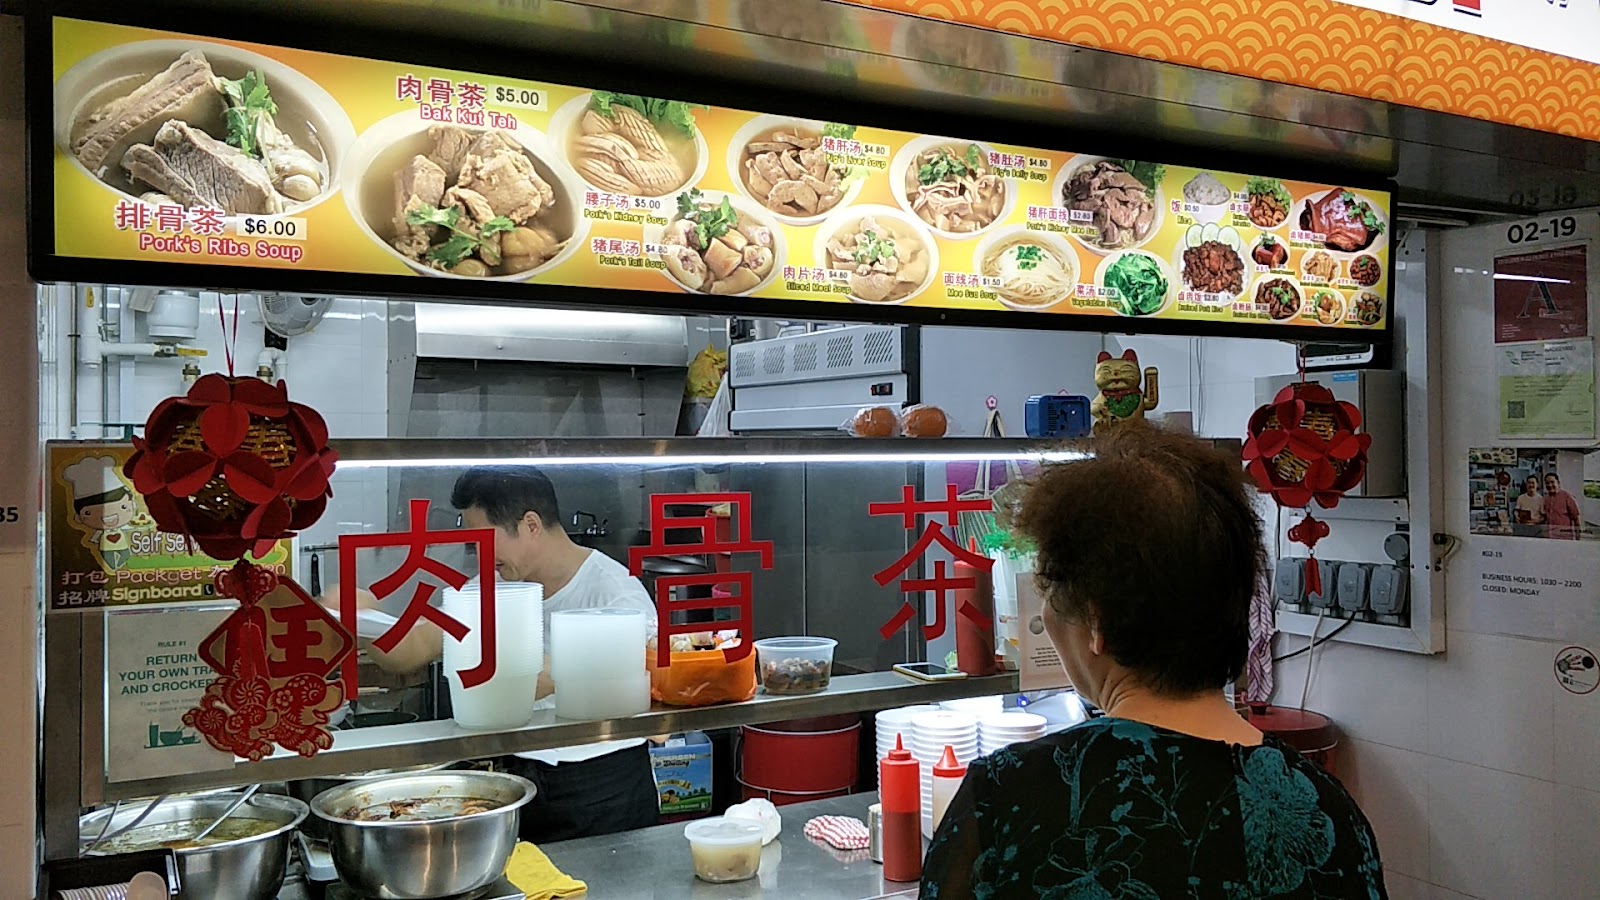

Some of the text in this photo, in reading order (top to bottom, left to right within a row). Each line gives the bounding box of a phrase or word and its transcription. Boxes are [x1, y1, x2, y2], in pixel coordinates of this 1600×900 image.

[398, 76, 539, 107] 肉骨茶 $5.00
[420, 103, 516, 130] Bak Kut Teh
[867, 158, 886, 169] Soup
[1030, 171, 1047, 182] Soup
[585, 192, 661, 209] 腰子汤 $5.00
[116, 202, 296, 236] 排骨茶 $6.00
[584, 208, 668, 226] Pork's Kidney Soup
[1507, 216, 1577, 244] 02-19
[140, 233, 303, 262] Pork's Ribs Soup
[593, 238, 668, 255] 猪尾汤 $4.80
[600, 254, 667, 270] Pork's Tail Soup
[783, 266, 824, 281] 肉片汤
[944, 273, 979, 286] 面线汤
[786, 282, 810, 291] Sliced
[833, 284, 851, 294] Soup
[131, 531, 163, 554] Self
[61, 570, 110, 586] 打包
[115, 568, 202, 585] Packget
[1482, 573, 1512, 582] BUSINESS
[1564, 580, 1582, 588] 2200
[57, 584, 202, 606] 招牌 Signboard
[1509, 587, 1540, 596] MONDAY
[146, 653, 198, 666] RETURN
[119, 665, 219, 682] YOUR OWN TRA
[121, 678, 216, 695] AND CROCKER
